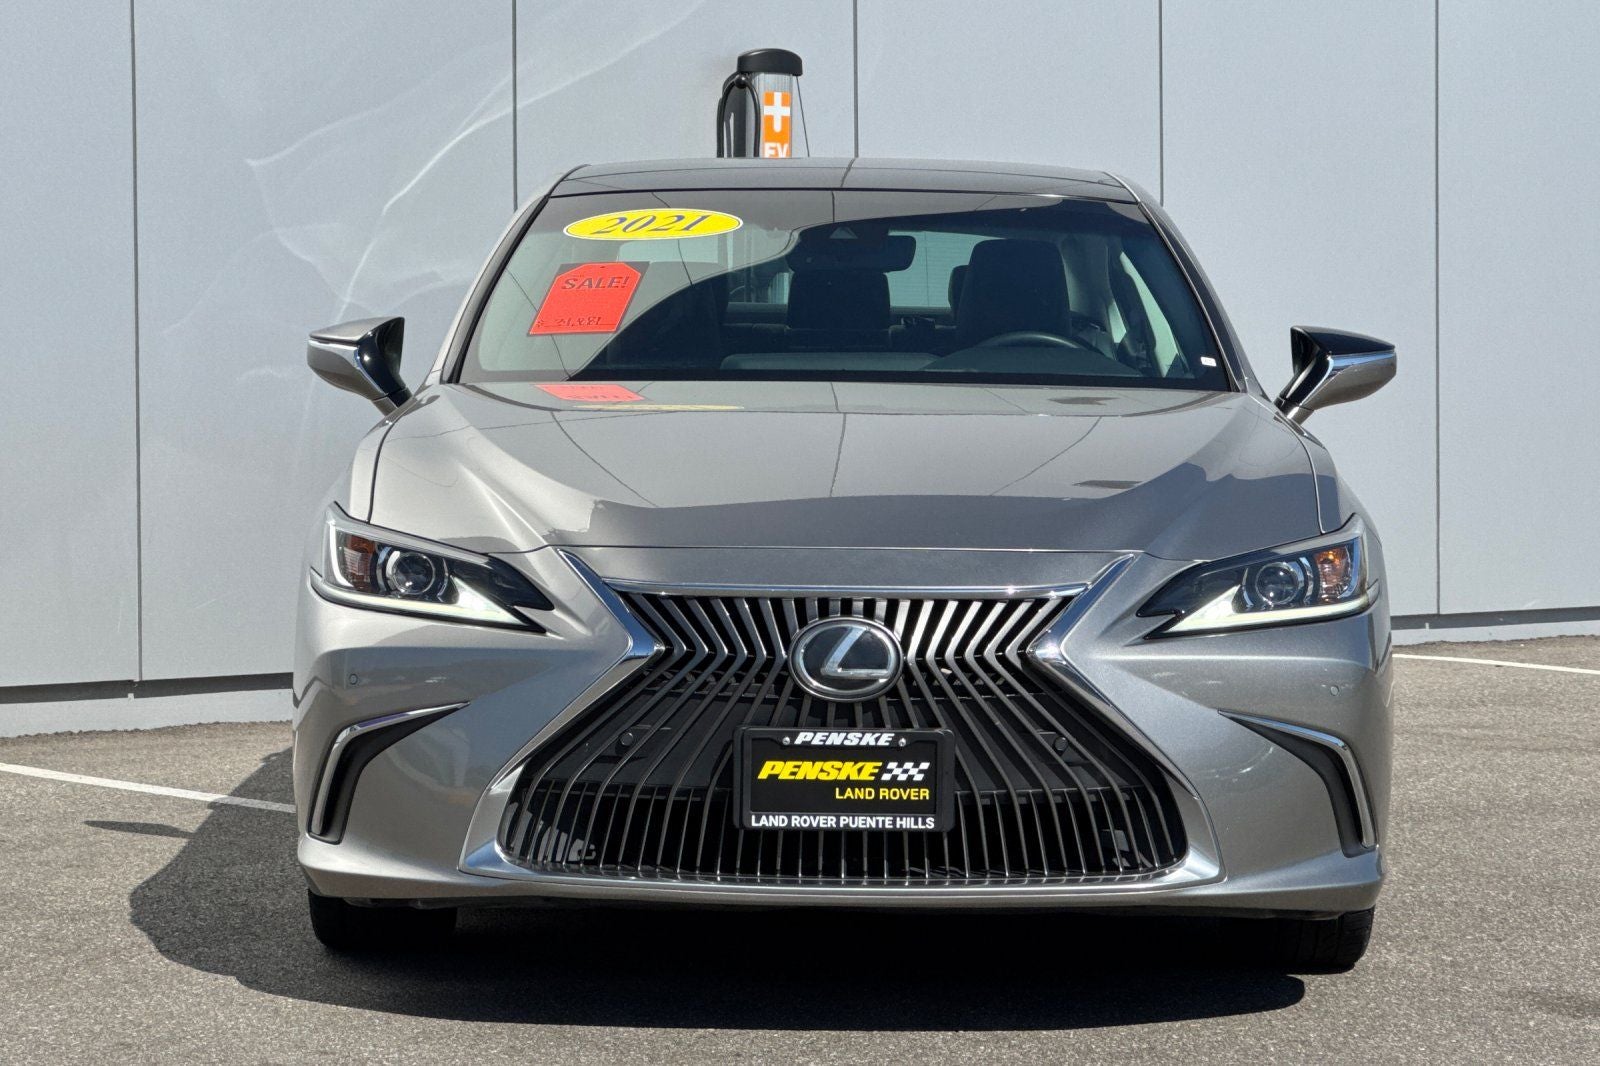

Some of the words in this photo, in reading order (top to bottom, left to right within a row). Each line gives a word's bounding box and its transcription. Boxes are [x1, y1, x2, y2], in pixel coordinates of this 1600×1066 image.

[764, 143, 788, 158] EV
[590, 215, 712, 235] 2021
[561, 276, 629, 290] SALE!
[794, 732, 895, 746] PENSKE
[757, 761, 882, 780] PENSKE
[835, 787, 875, 799] LAND
[879, 788, 930, 800] ROVER
[751, 815, 788, 827] LAND
[791, 815, 836, 828] ROVER
[839, 816, 893, 829] PUENTE
[896, 817, 935, 829] HILLS
